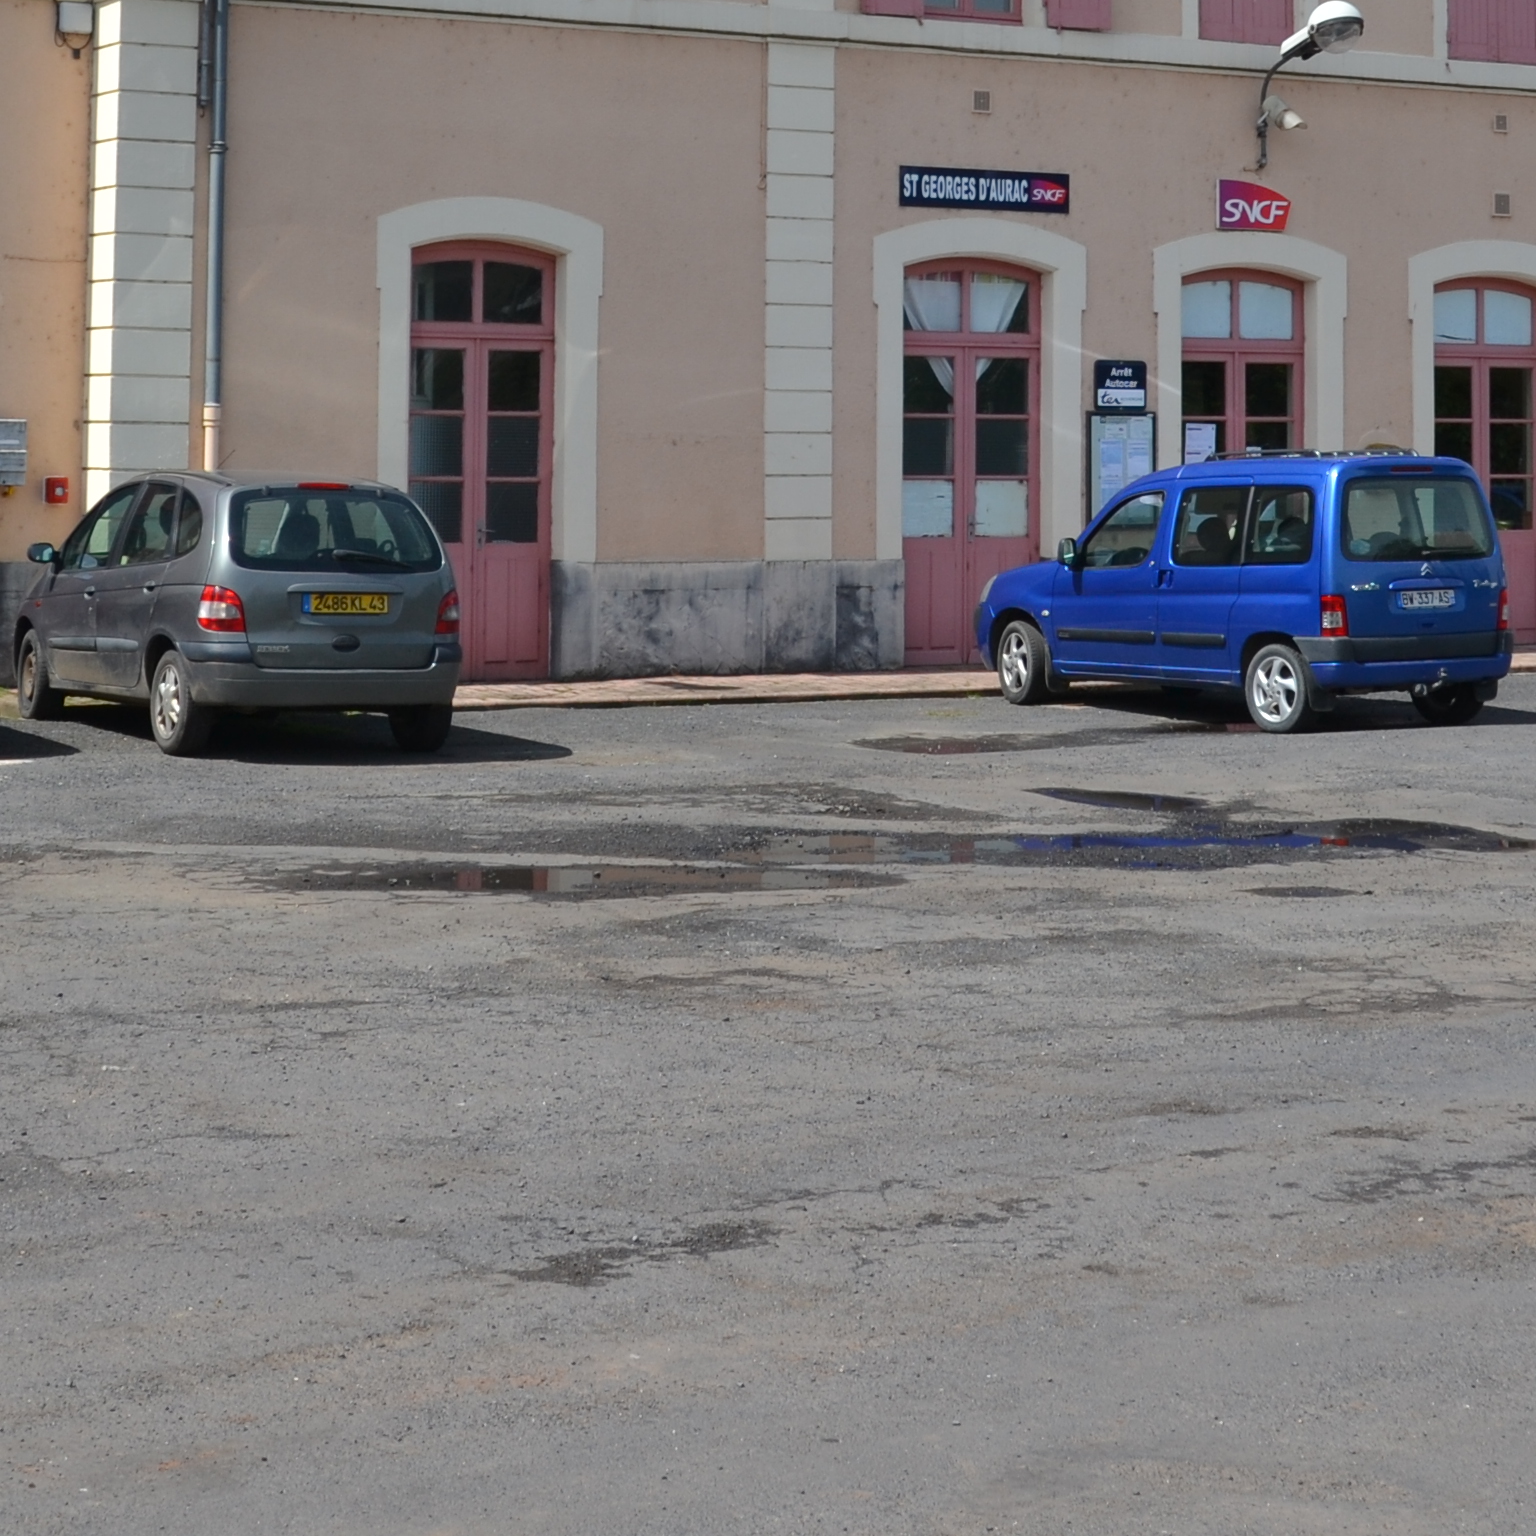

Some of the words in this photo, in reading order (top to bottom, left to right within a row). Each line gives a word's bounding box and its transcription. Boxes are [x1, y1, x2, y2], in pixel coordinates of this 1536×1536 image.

[903, 173, 919, 197] ST
[921, 174, 976, 201] GEORGES
[978, 177, 1029, 203] D'AURAC
[1031, 188, 1066, 202] SNCF
[1221, 198, 1289, 224] SNCF
[1110, 367, 1133, 377] Arrêt
[1104, 378, 1139, 388] Autocar
[314, 594, 348, 610] 2486
[350, 594, 367, 611] KL
[368, 594, 386, 610] 43
